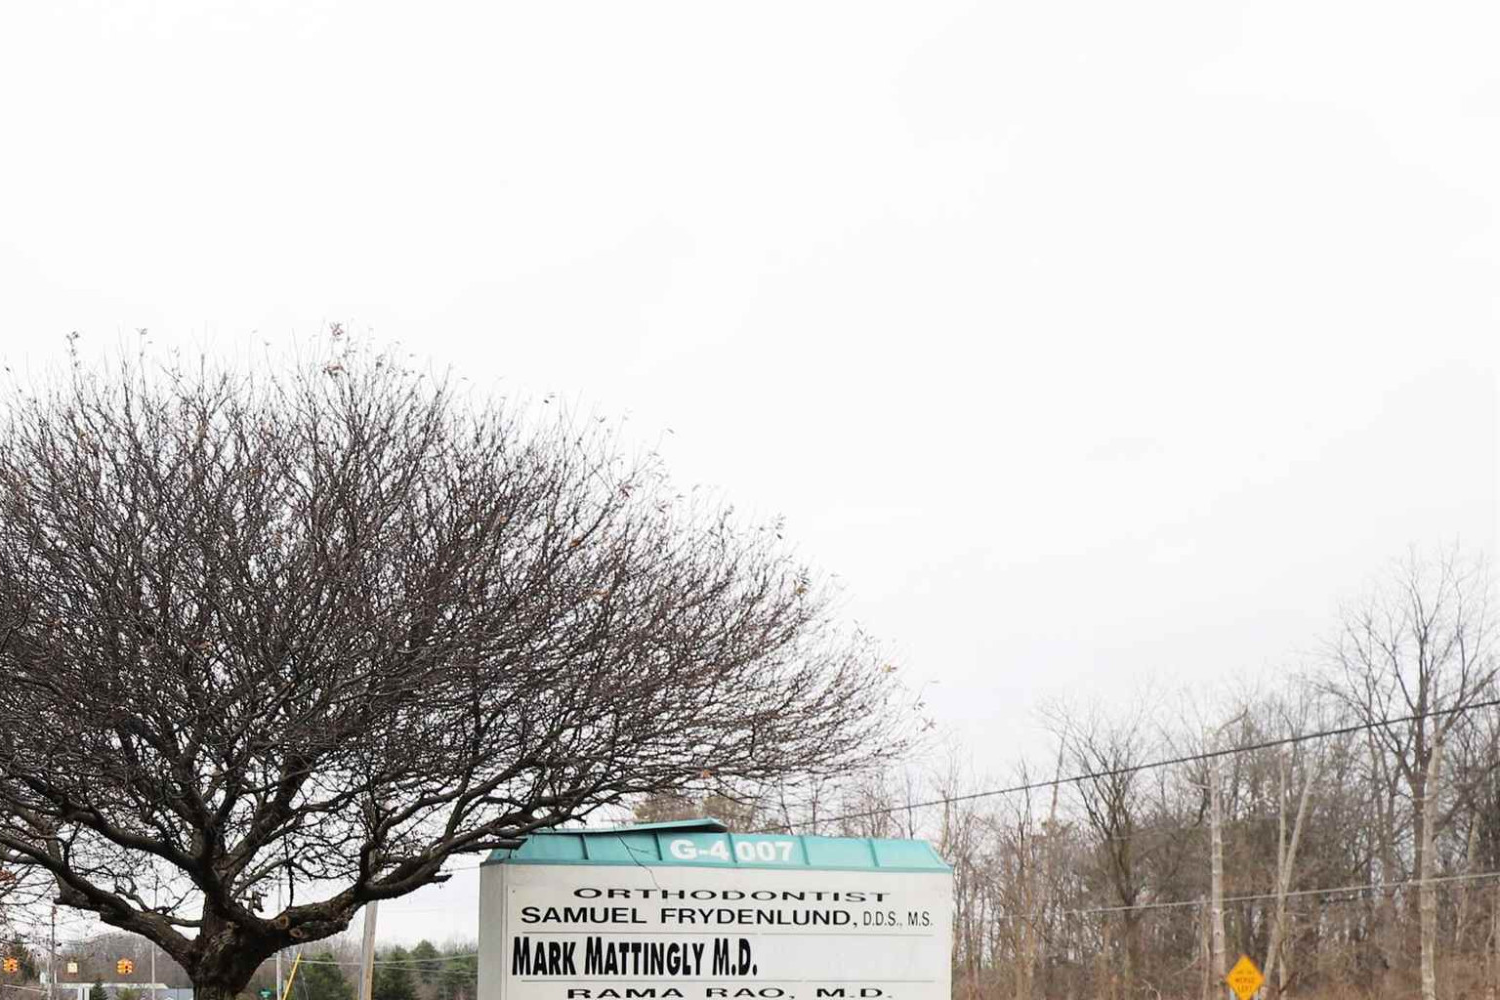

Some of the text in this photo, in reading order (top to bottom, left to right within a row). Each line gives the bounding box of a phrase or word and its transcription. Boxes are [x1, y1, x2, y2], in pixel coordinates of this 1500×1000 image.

[573, 887, 890, 902] ORTHODONTIST
[521, 906, 648, 924] SAMUEL
[661, 908, 858, 928] FRYDENLUND,
[908, 912, 933, 927] M.S.
[512, 936, 758, 976] MARK MATTINGLY M.D.
[567, 988, 893, 999] RAMA RAO, M.D.
